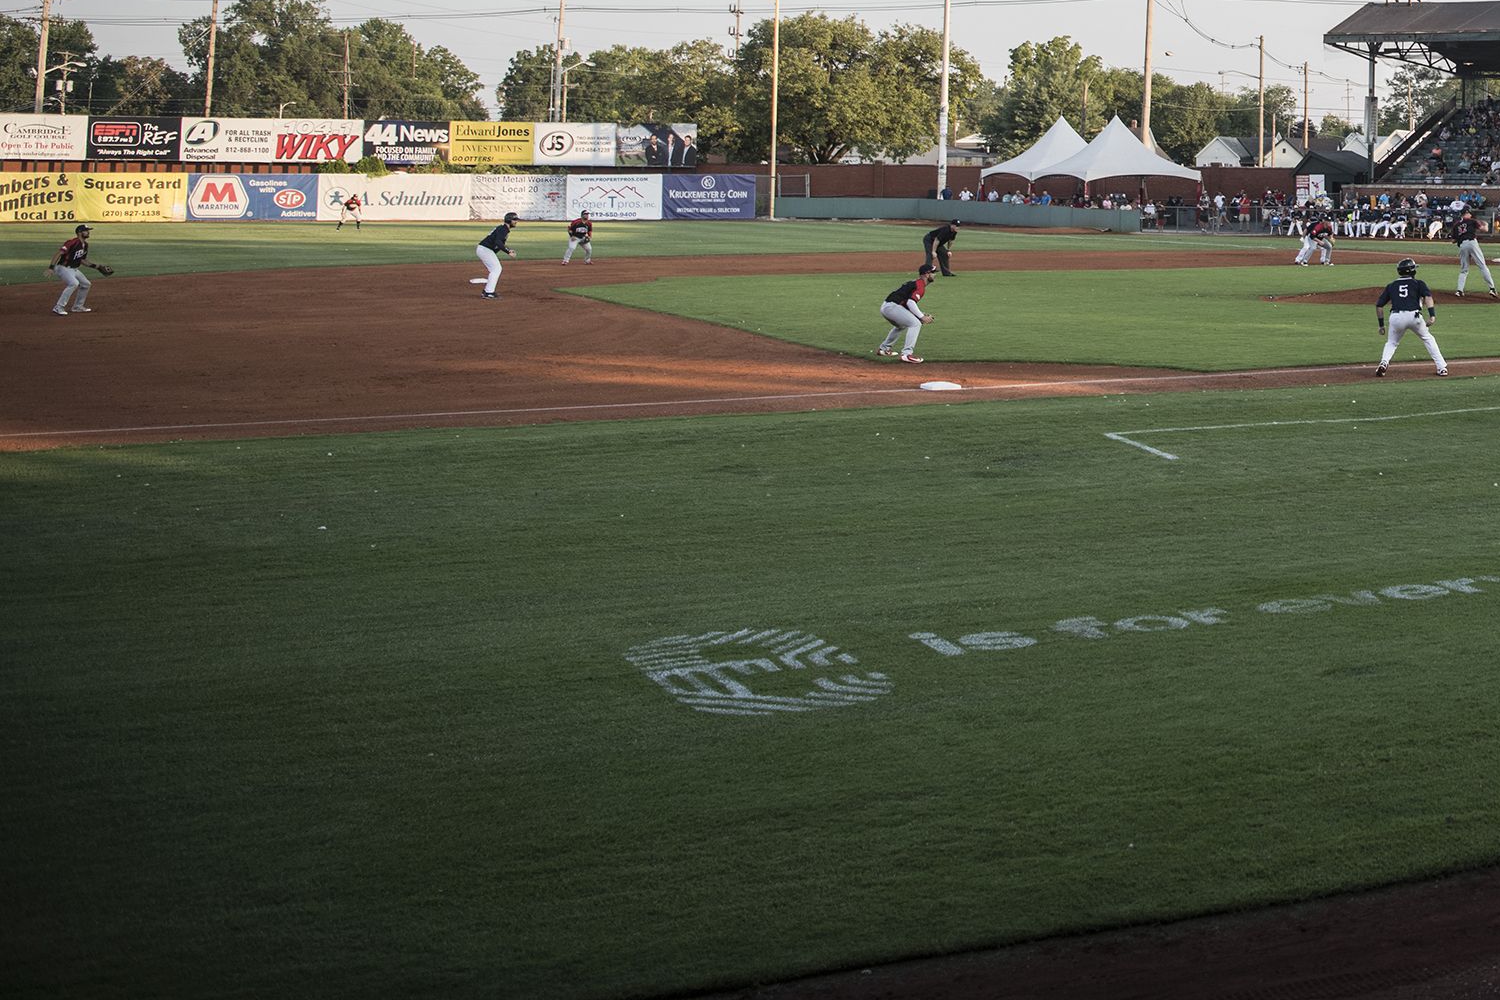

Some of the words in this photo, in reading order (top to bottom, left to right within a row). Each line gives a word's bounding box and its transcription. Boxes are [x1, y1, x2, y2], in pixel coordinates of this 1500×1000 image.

[4, 122, 71, 135] CAMBRIDGE
[94, 124, 138, 136] ESPN
[143, 122, 159, 132] The
[282, 121, 354, 136] 104.1
[456, 125, 496, 136] Edward
[495, 126, 530, 138] Jones
[142, 131, 178, 145] REF
[364, 124, 398, 145] 44
[399, 125, 449, 143] News
[0, 142, 21, 151] Open
[35, 142, 49, 150] The
[50, 142, 74, 150] Public
[136, 149, 154, 157] Right
[275, 134, 360, 160] WIKY
[375, 146, 403, 154] FOCUSED
[185, 153, 216, 161] Disposal
[400, 153, 436, 161] COMMUNIT
[57, 173, 69, 186] &
[84, 178, 142, 191] Square
[147, 179, 182, 189] Yard
[249, 179, 288, 187] Gasolines
[106, 193, 160, 206] Carpet
[200, 183, 238, 203] M
[278, 191, 301, 205] STP
[361, 191, 374, 206] A.
[378, 191, 463, 206] Schulman
[669, 190, 719, 198] KRUCKEMEYER
[720, 190, 726, 198] &
[727, 189, 748, 198] COHN
[14, 210, 47, 220] Local
[53, 211, 75, 220] 136
[1399, 284, 1409, 298] 5
